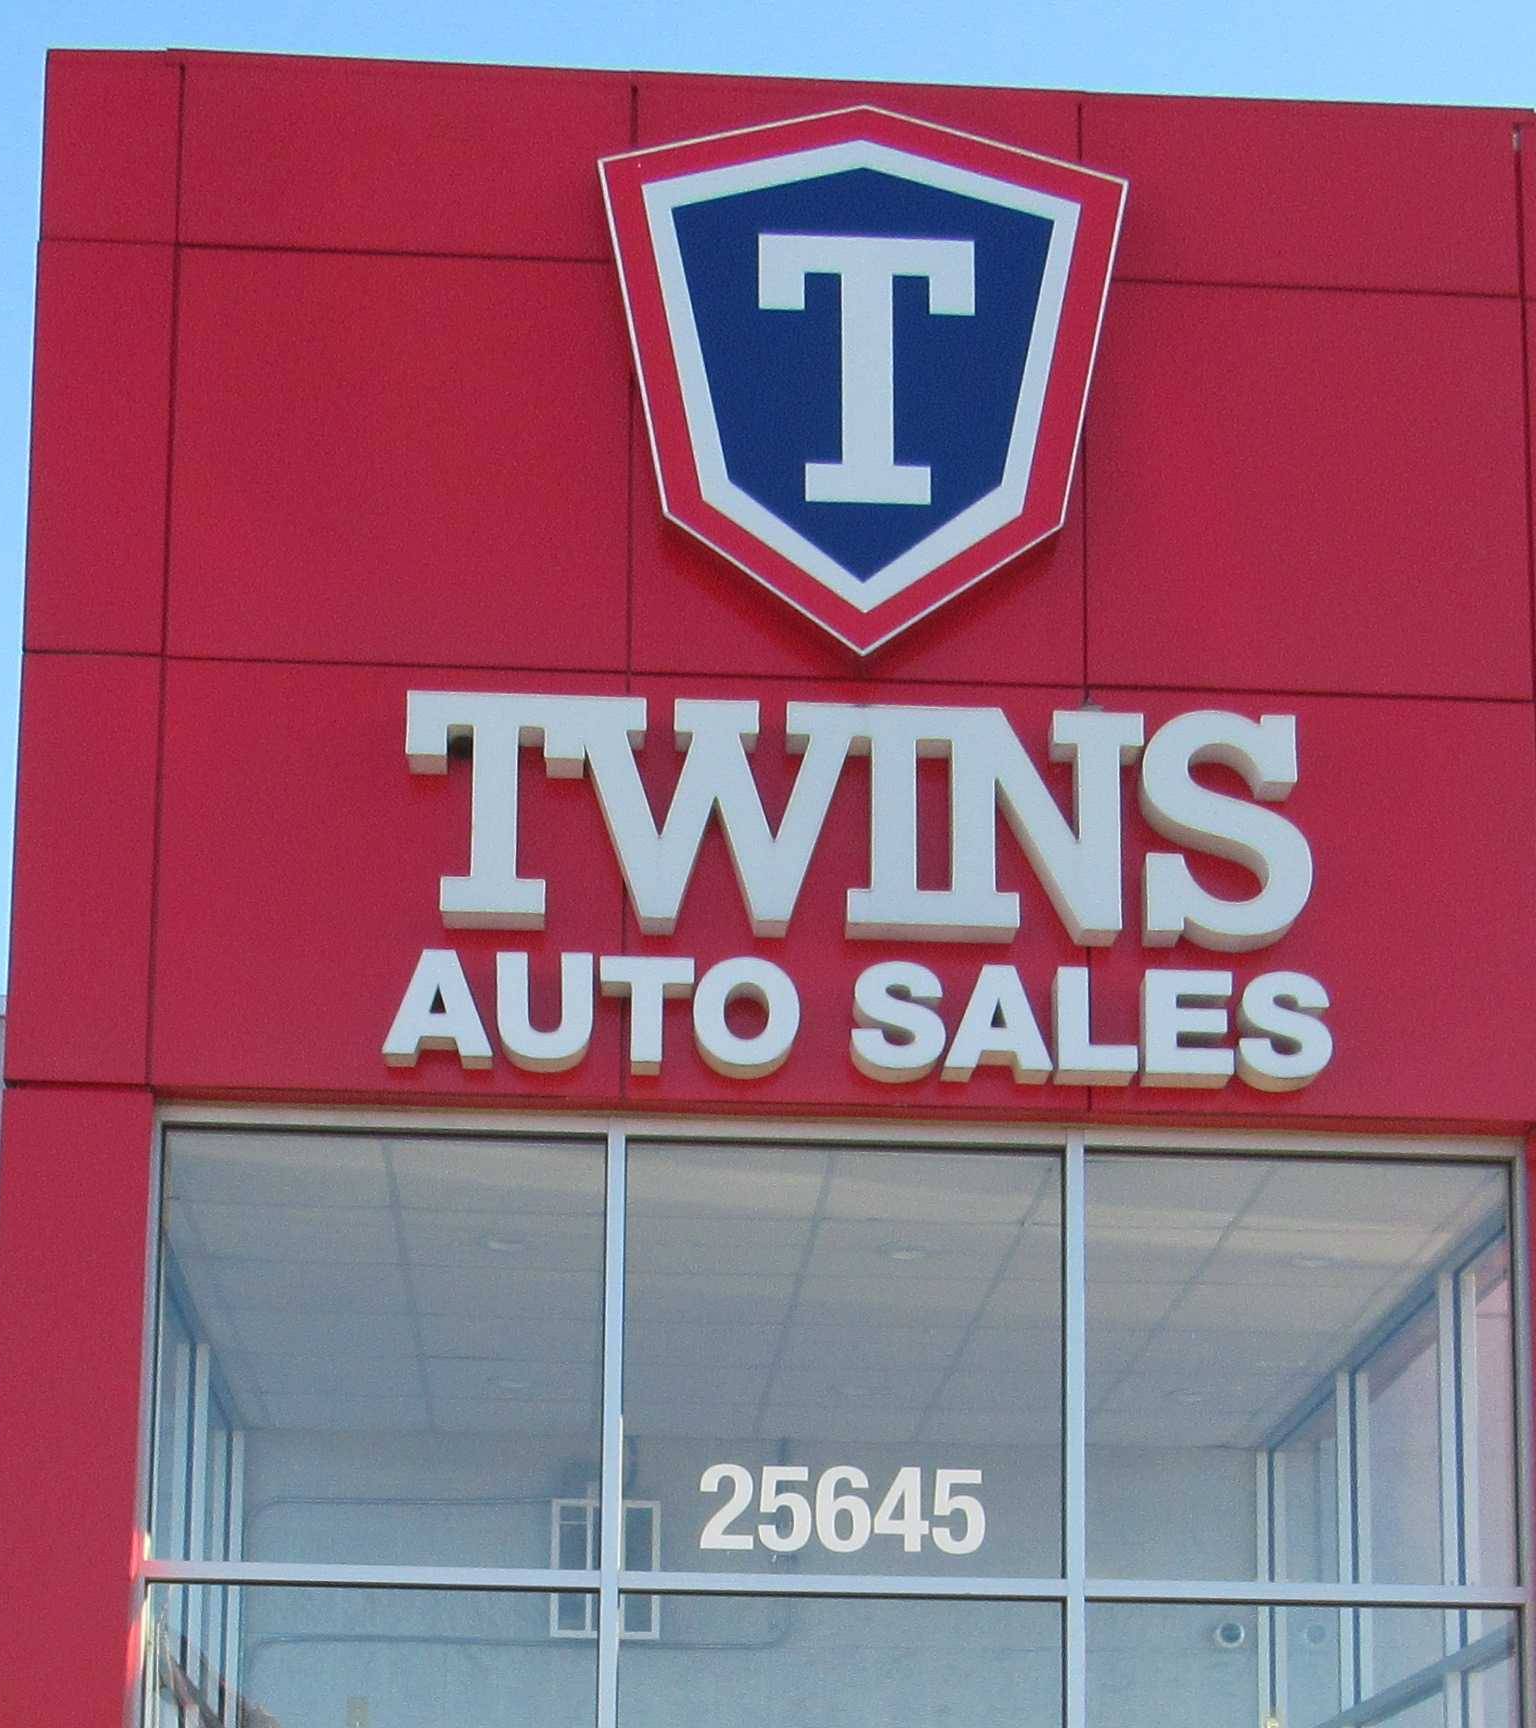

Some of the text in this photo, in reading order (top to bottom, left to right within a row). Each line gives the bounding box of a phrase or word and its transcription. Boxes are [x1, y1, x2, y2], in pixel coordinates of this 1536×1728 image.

[758, 232, 976, 506] T
[406, 690, 1313, 953] TWINS
[381, 949, 1333, 1092] AUTO SALES
[699, 1463, 986, 1555] 25645
